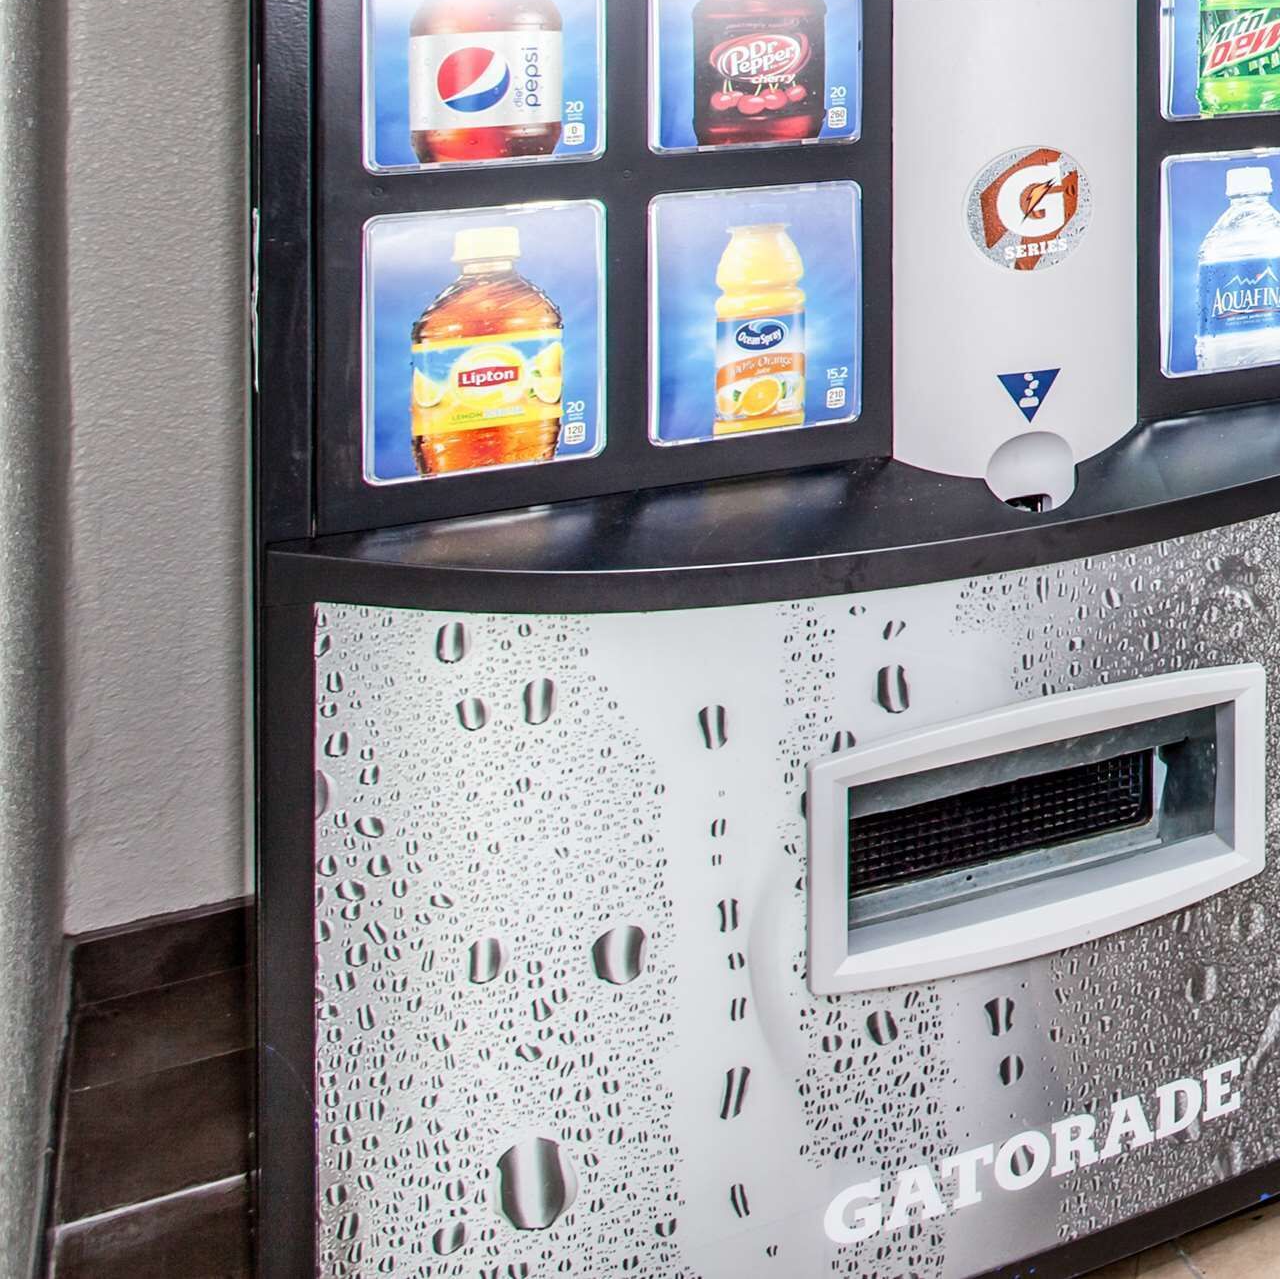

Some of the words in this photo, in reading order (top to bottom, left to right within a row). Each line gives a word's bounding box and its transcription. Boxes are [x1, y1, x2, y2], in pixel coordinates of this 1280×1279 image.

[750, 40, 778, 58] Dr
[727, 44, 795, 76] Pepper
[521, 46, 542, 107] pepsi
[751, 73, 796, 84] cherry
[830, 86, 847, 98] 20
[565, 100, 585, 113] 20
[1004, 237, 1068, 261] SERIES
[738, 332, 761, 345] Ocean
[760, 328, 782, 346] Spray
[462, 368, 515, 386] Lipton
[826, 366, 849, 380] 15.2
[566, 400, 586, 414] 20
[567, 425, 584, 435] 120
[823, 1058, 1242, 1245] GATORADE
